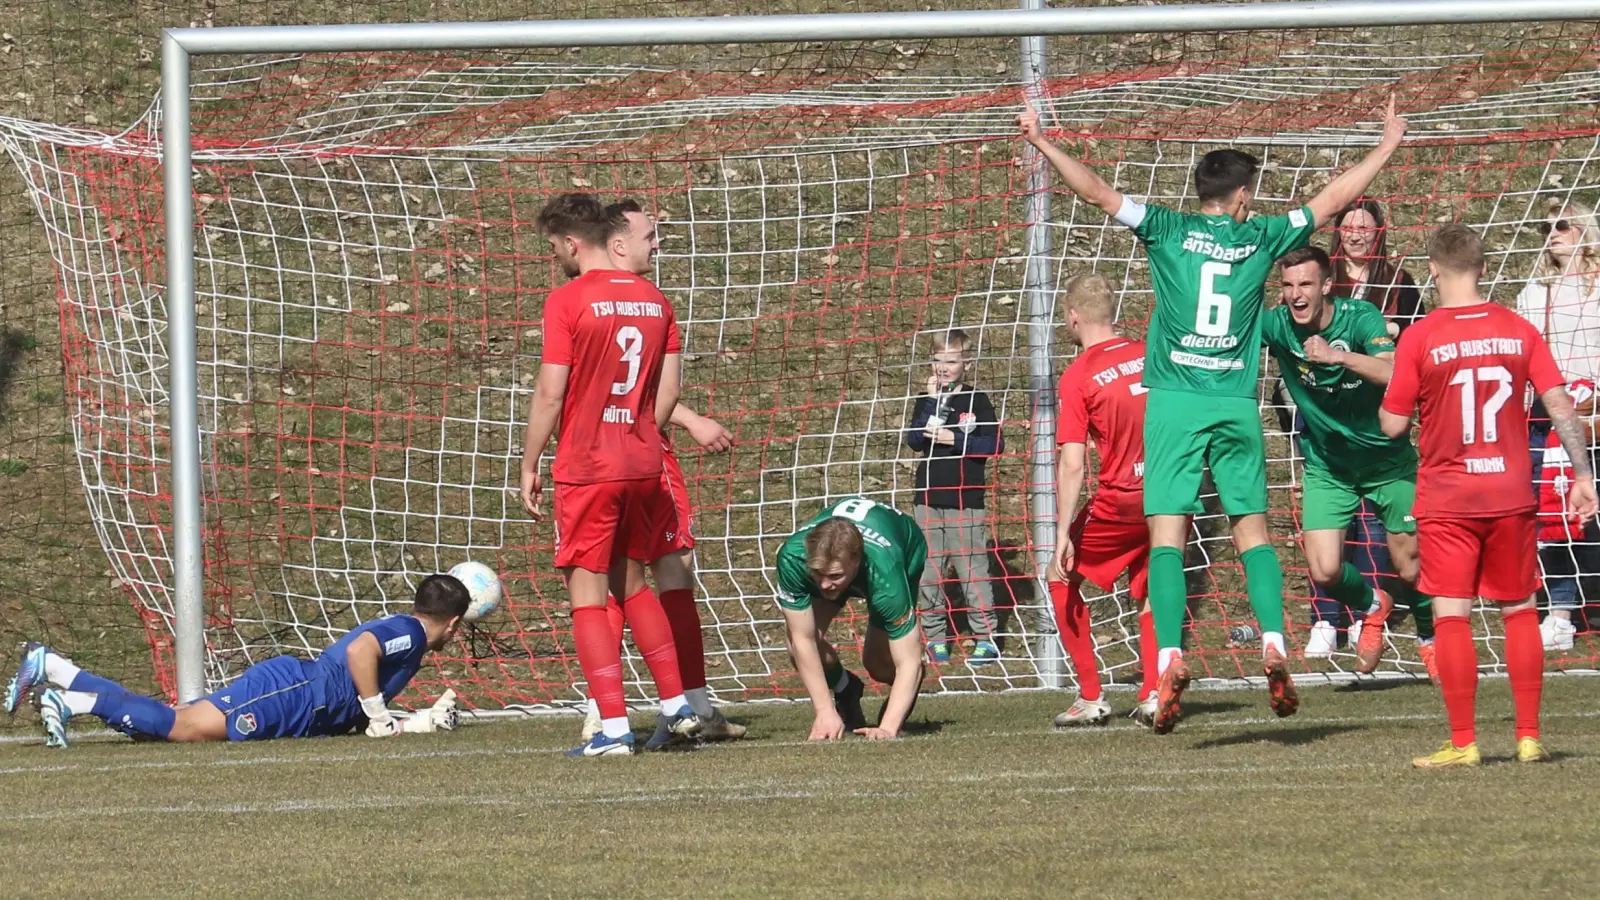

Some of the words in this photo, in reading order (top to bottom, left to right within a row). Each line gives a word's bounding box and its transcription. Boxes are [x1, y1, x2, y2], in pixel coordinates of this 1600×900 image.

[1182, 237, 1257, 261] ansbach
[590, 301, 615, 317] TSV
[616, 301, 663, 318] AUBSTADT
[1195, 261, 1232, 337] 6
[1180, 333, 1238, 349] dietrich
[1430, 342, 1459, 366] TSV
[1459, 338, 1523, 358] AUBSTADT
[611, 325, 643, 396] 3
[1092, 366, 1119, 387] TSV
[602, 405, 635, 424] HÜTTL
[1449, 365, 1513, 445] 17
[1464, 456, 1506, 474] TRUNK
